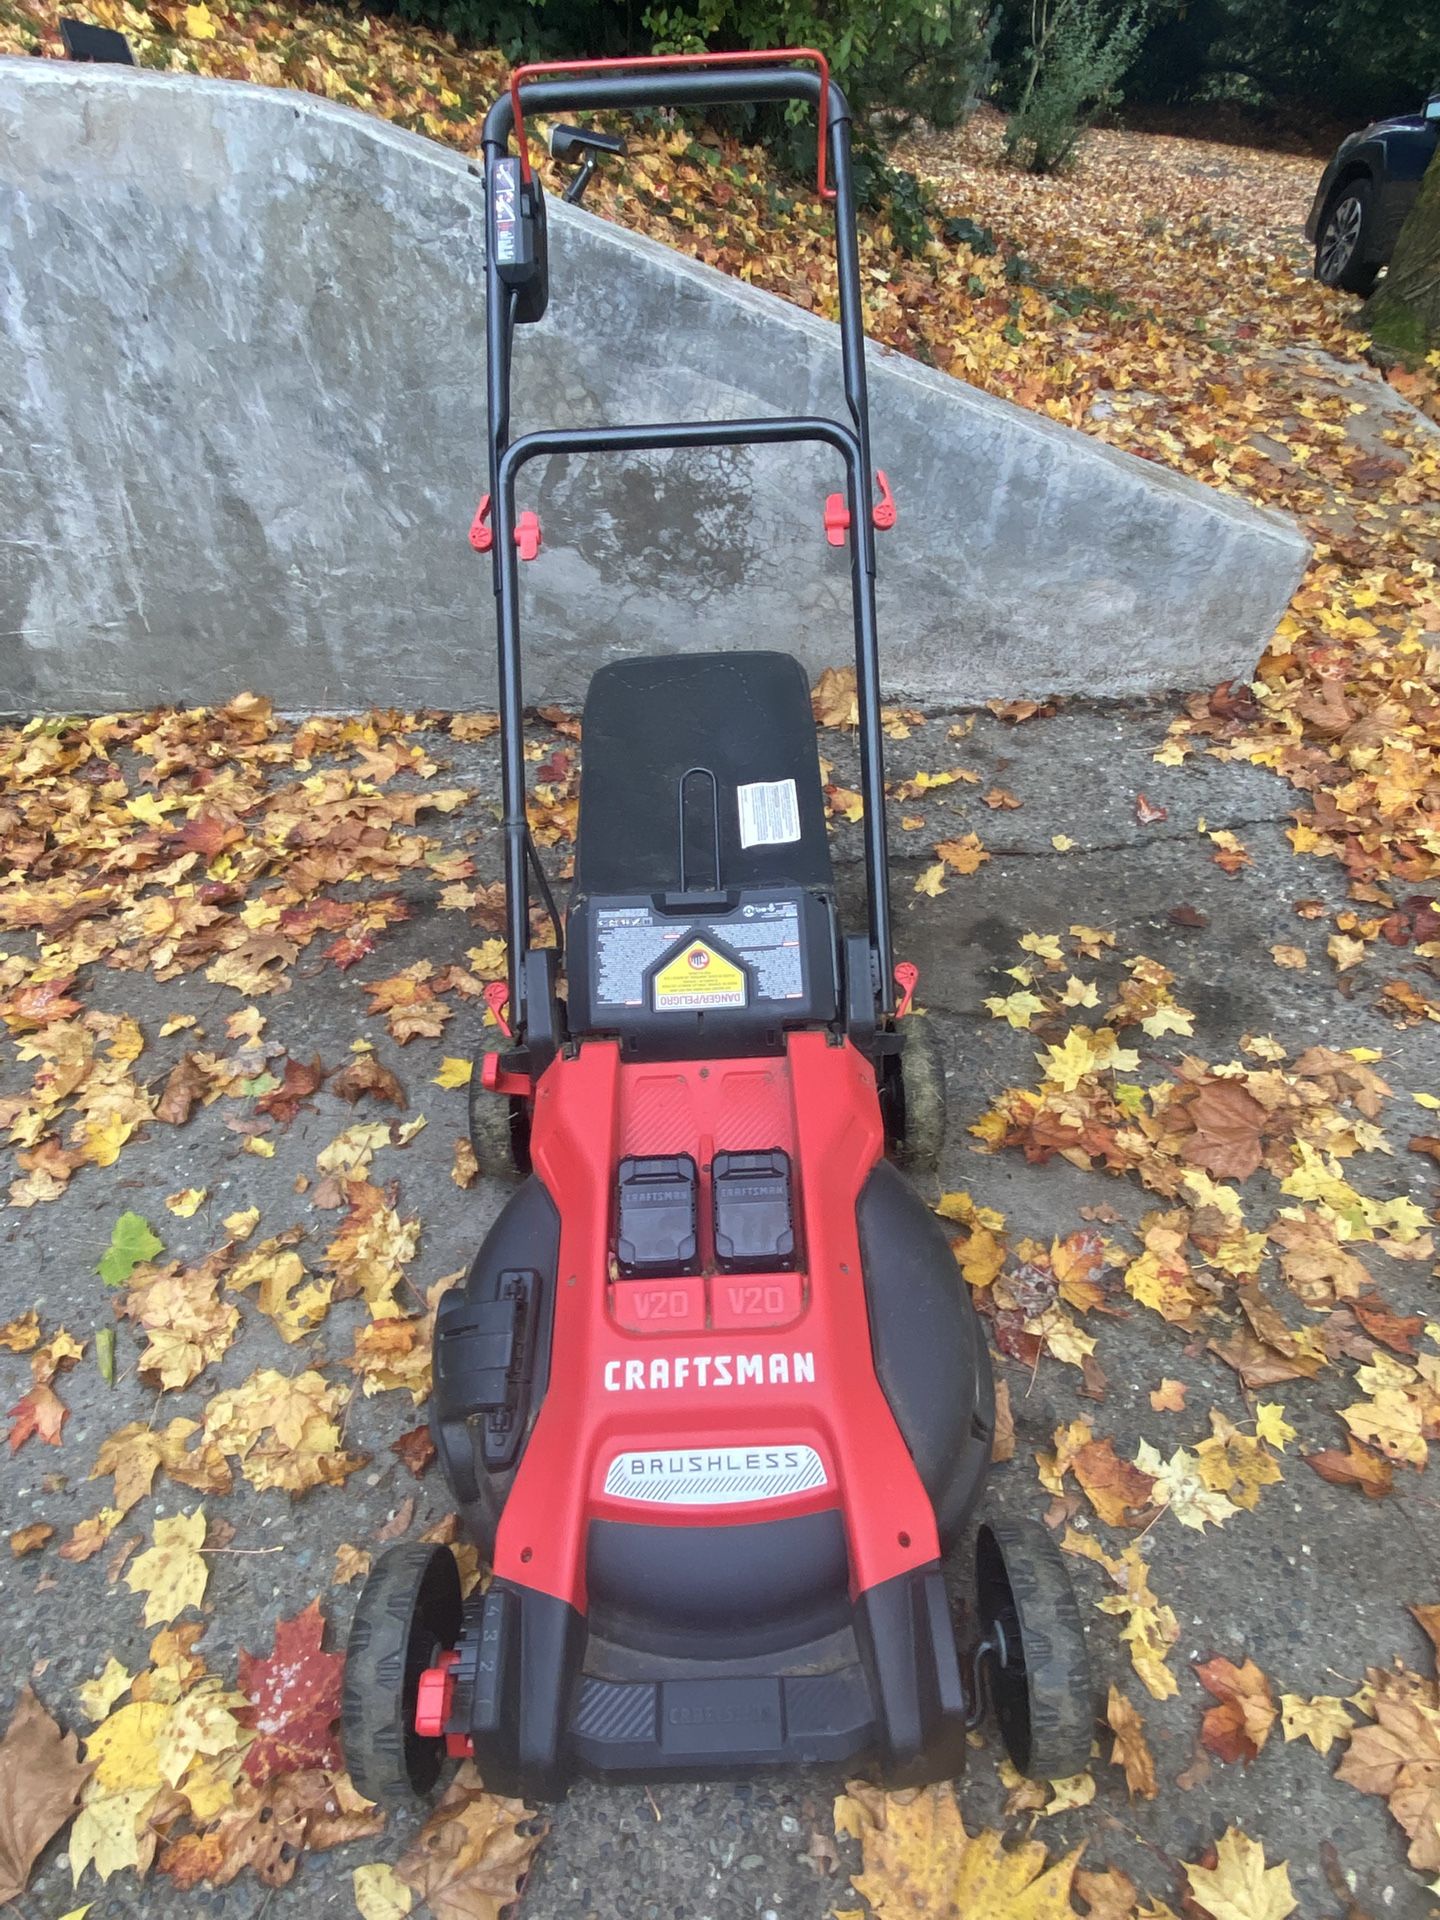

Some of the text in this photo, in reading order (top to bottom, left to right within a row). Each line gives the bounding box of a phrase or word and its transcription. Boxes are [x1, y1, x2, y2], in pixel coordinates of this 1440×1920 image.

[660, 993, 741, 1006] DANGER/PELIGRO
[625, 1191, 688, 1202] CRAFTSMAN
[720, 1186, 784, 1198] CRAFTSMAN
[632, 1291, 689, 1320] V20
[728, 1286, 785, 1315] V20
[604, 1352, 816, 1391] CRAFTSMAN
[631, 1452, 798, 1475] BRUSHLESS
[483, 1630, 498, 1641] 3
[479, 1660, 495, 1672] 2
